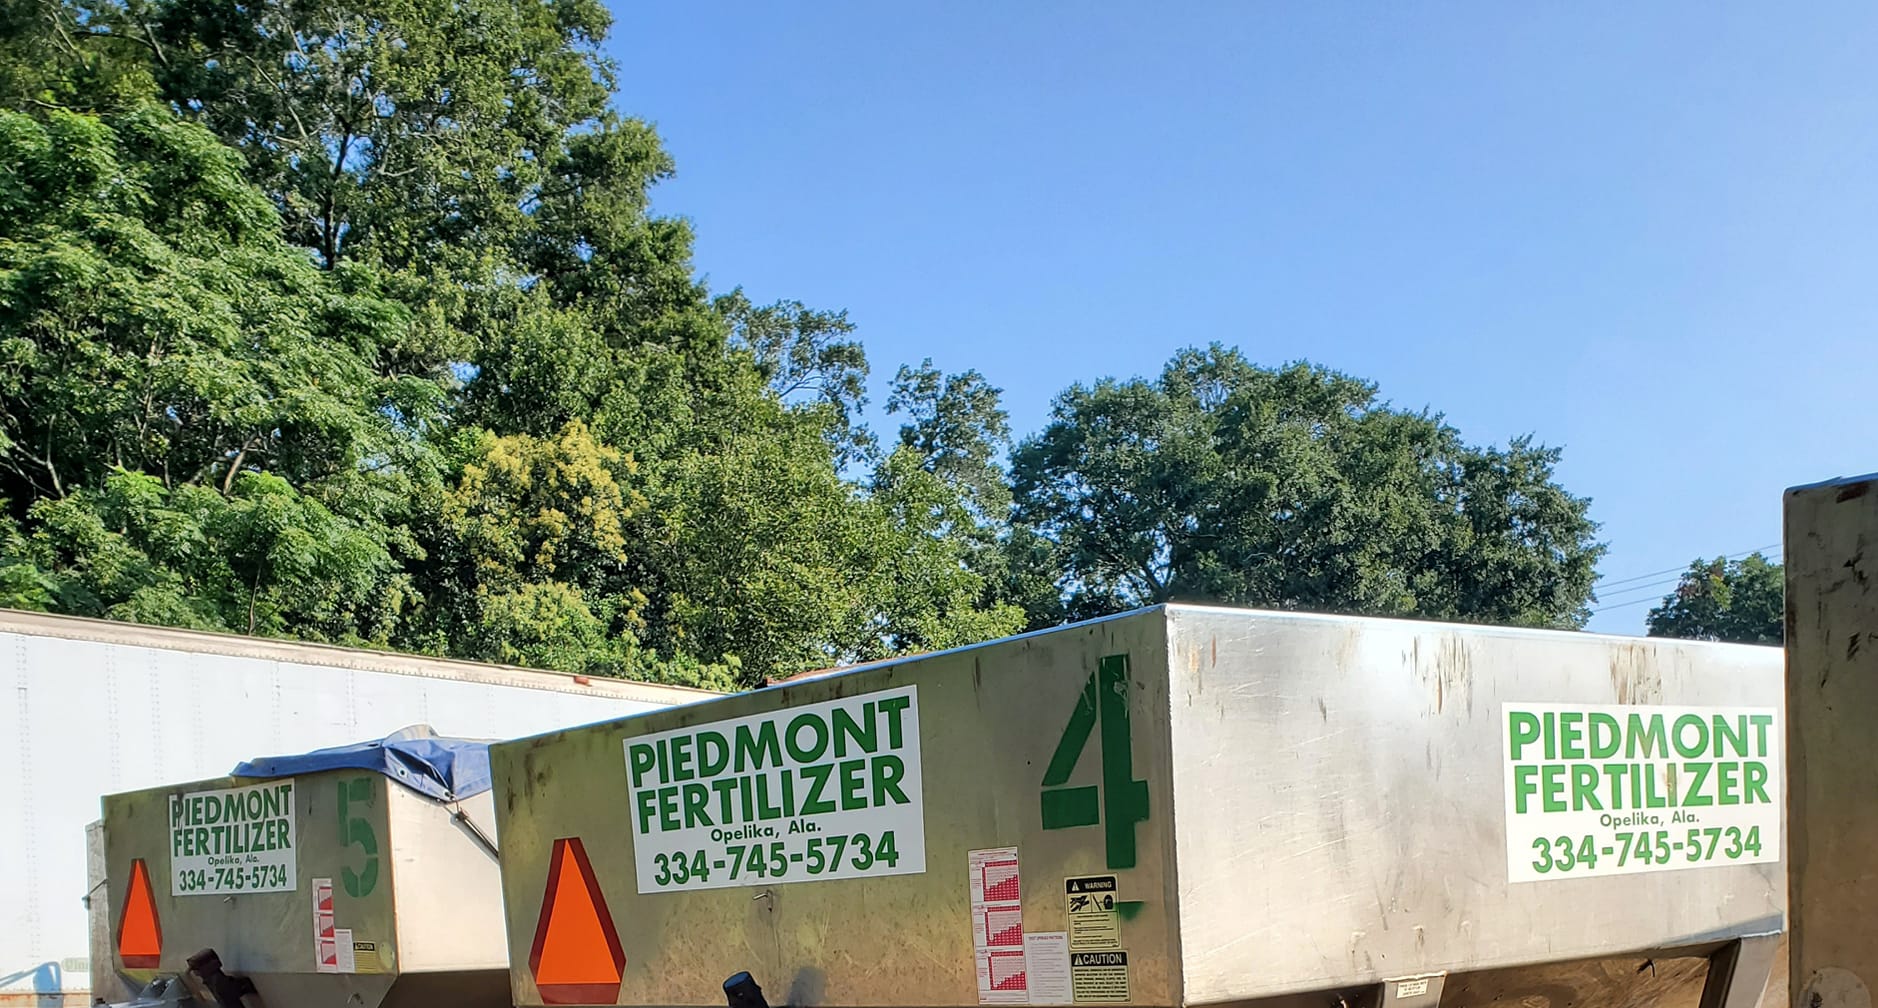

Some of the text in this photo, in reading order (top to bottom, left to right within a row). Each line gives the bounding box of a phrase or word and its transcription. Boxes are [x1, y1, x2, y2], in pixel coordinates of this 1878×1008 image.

[629, 695, 910, 788] PIEDMONT
[1509, 711, 1773, 760] PIEDMONT
[1041, 653, 1150, 870] 4
[171, 784, 292, 828] PIEDMONT
[637, 754, 911, 834] FERTILIZER
[1514, 761, 1772, 814] FERTILIZER
[173, 818, 291, 857] FERTILIZER
[336, 777, 379, 898] 5
[711, 819, 822, 843] Opelika, Ala.
[1600, 810, 1700, 830] Opelika, Ala.
[654, 831, 899, 886] 334-745-5734
[1532, 825, 1762, 874] 334-745-5734
[179, 864, 287, 891] 334-745-5734
[1084, 881, 1112, 890] WARNING
[1083, 953, 1123, 965] CAUTION
